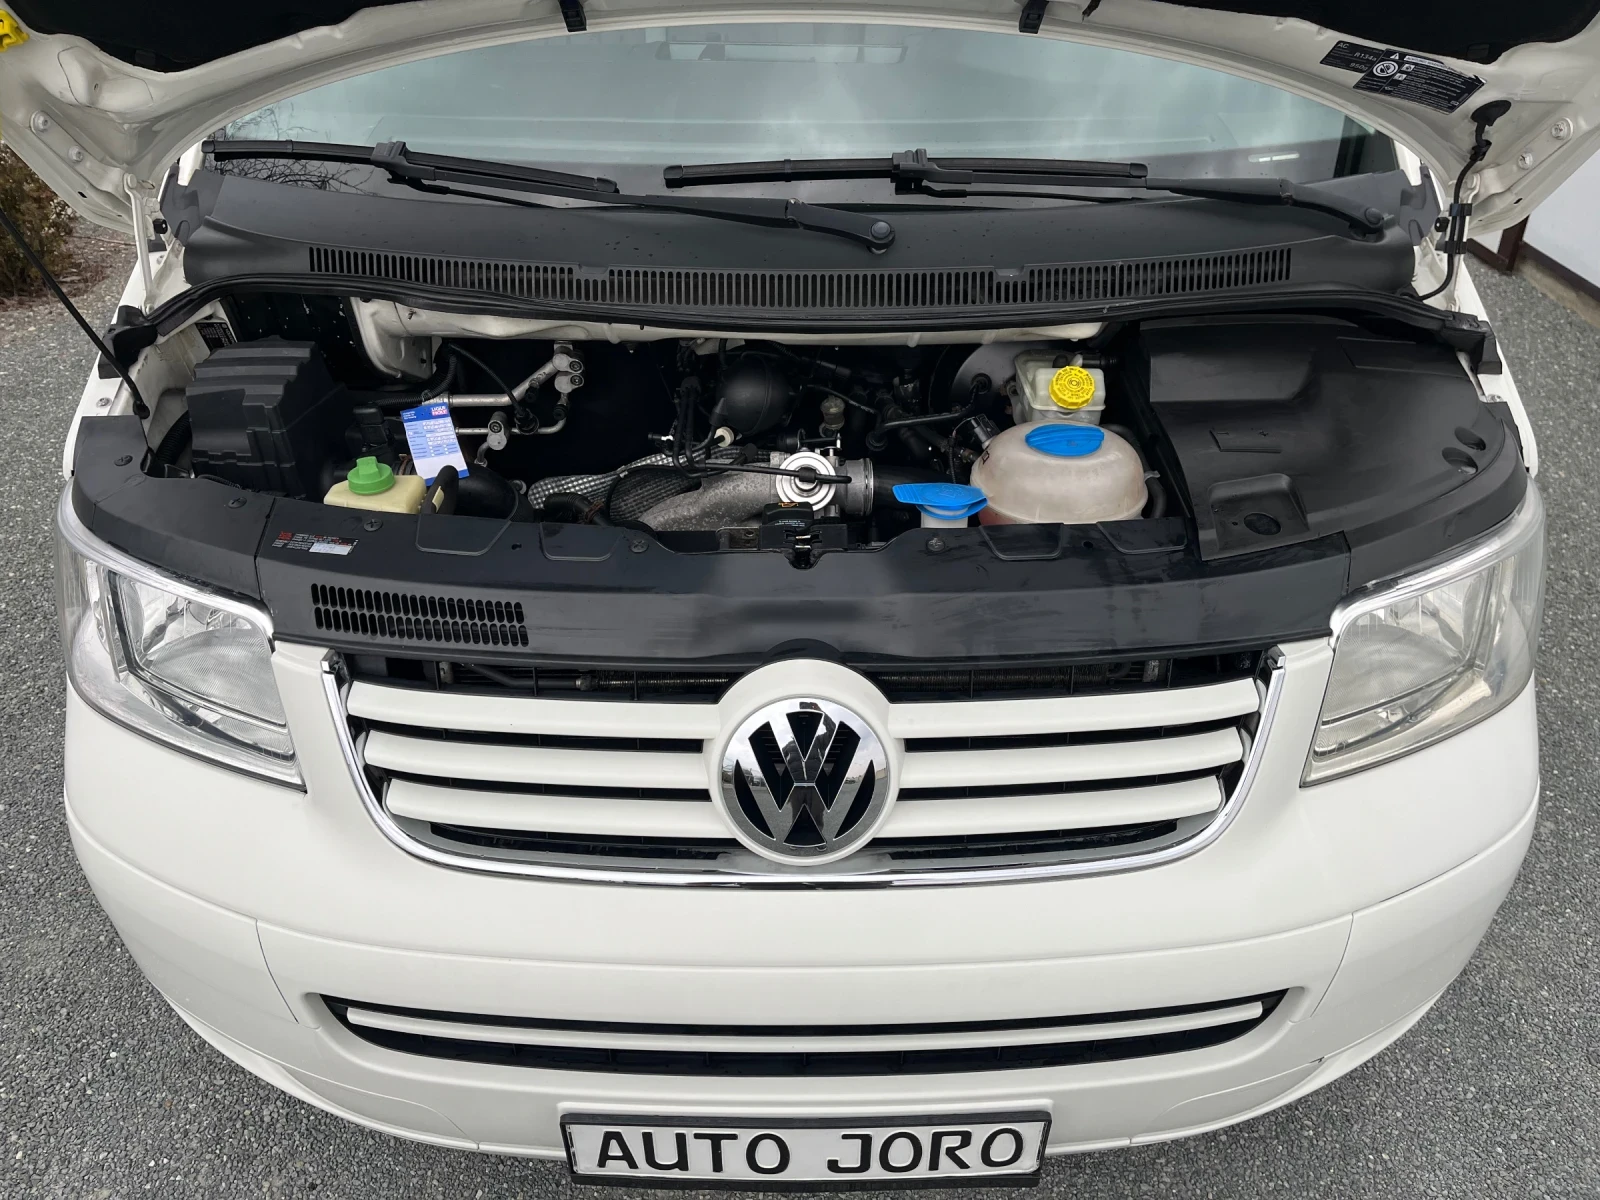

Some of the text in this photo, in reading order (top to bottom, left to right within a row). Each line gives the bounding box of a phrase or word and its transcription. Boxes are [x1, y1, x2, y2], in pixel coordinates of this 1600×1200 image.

[1353, 52, 1377, 61] R134a
[597, 1127, 1024, 1175] AUTO JORO
